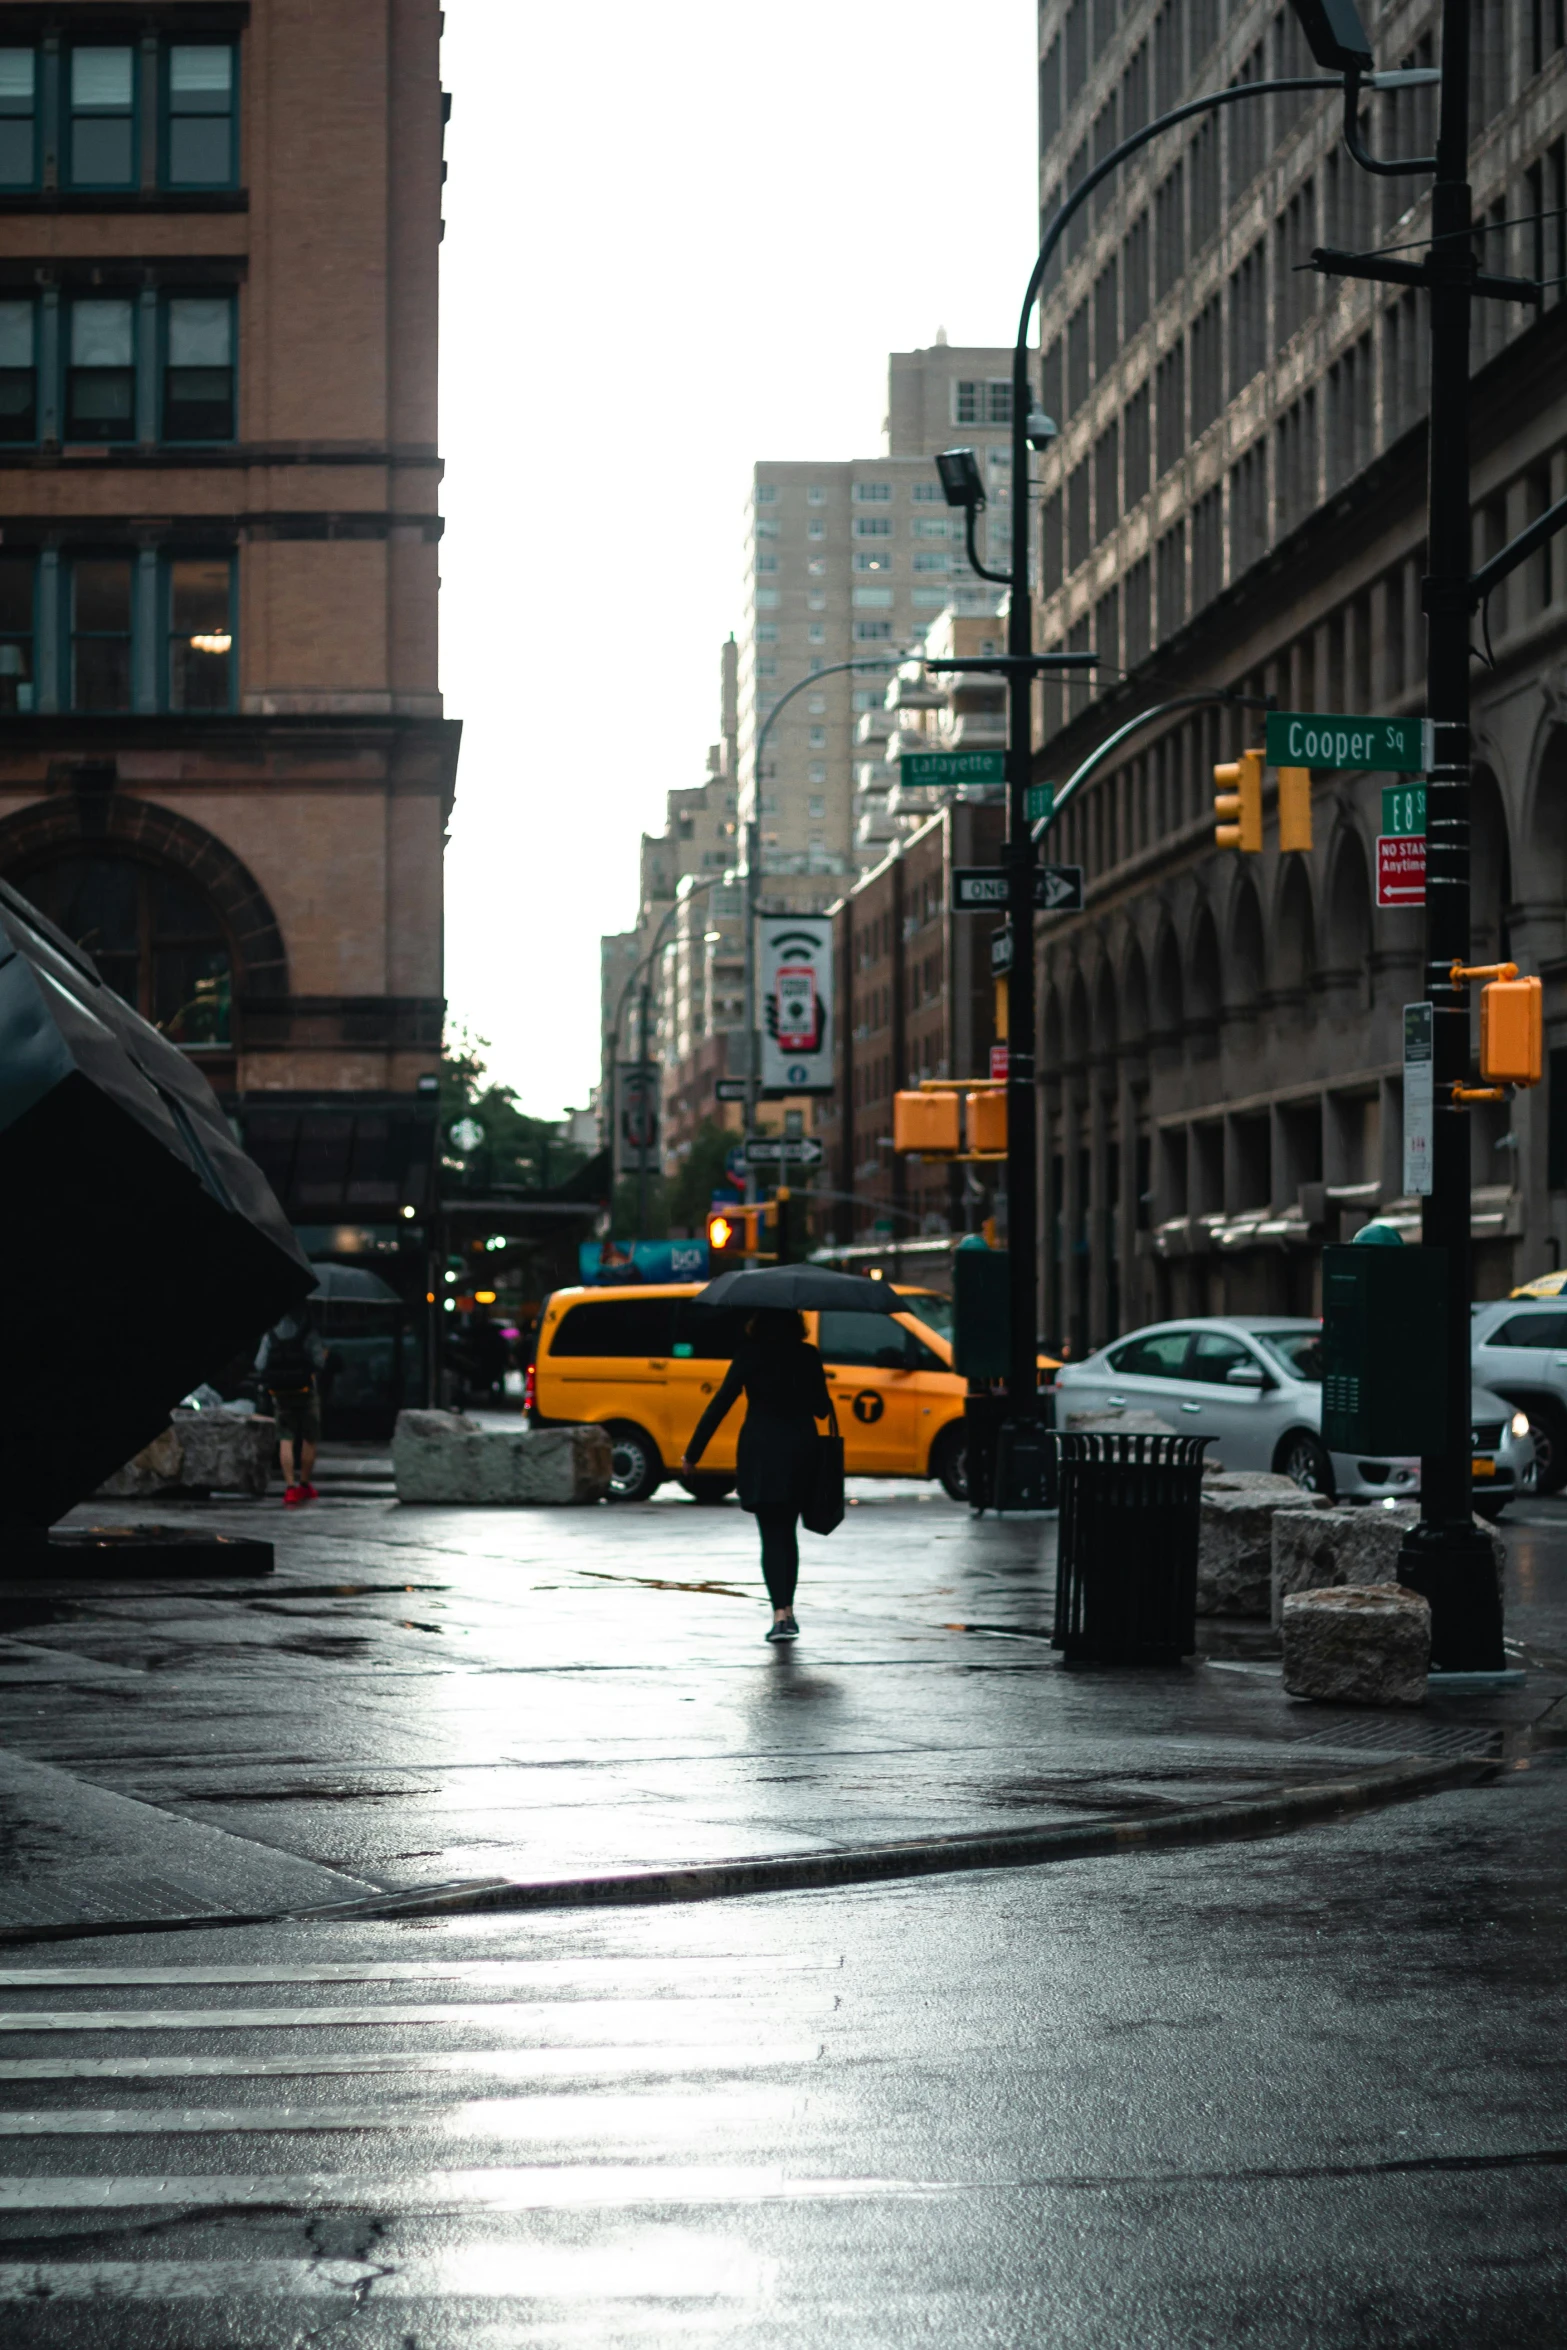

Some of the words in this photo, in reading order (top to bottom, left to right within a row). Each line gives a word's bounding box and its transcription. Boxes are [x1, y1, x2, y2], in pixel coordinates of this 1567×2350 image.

[1289, 721, 1375, 766] Cooper
[1386, 726, 1404, 753] Sq
[911, 756, 993, 776] Lafayette
[1393, 794, 1400, 832] E
[1405, 791, 1413, 831] 8
[1381, 843, 1397, 857] NO
[1382, 858, 1426, 874] Anytime
[971, 880, 1008, 898] ONE
[1032, 880, 1062, 898] AY
[859, 1395, 878, 1418] T
